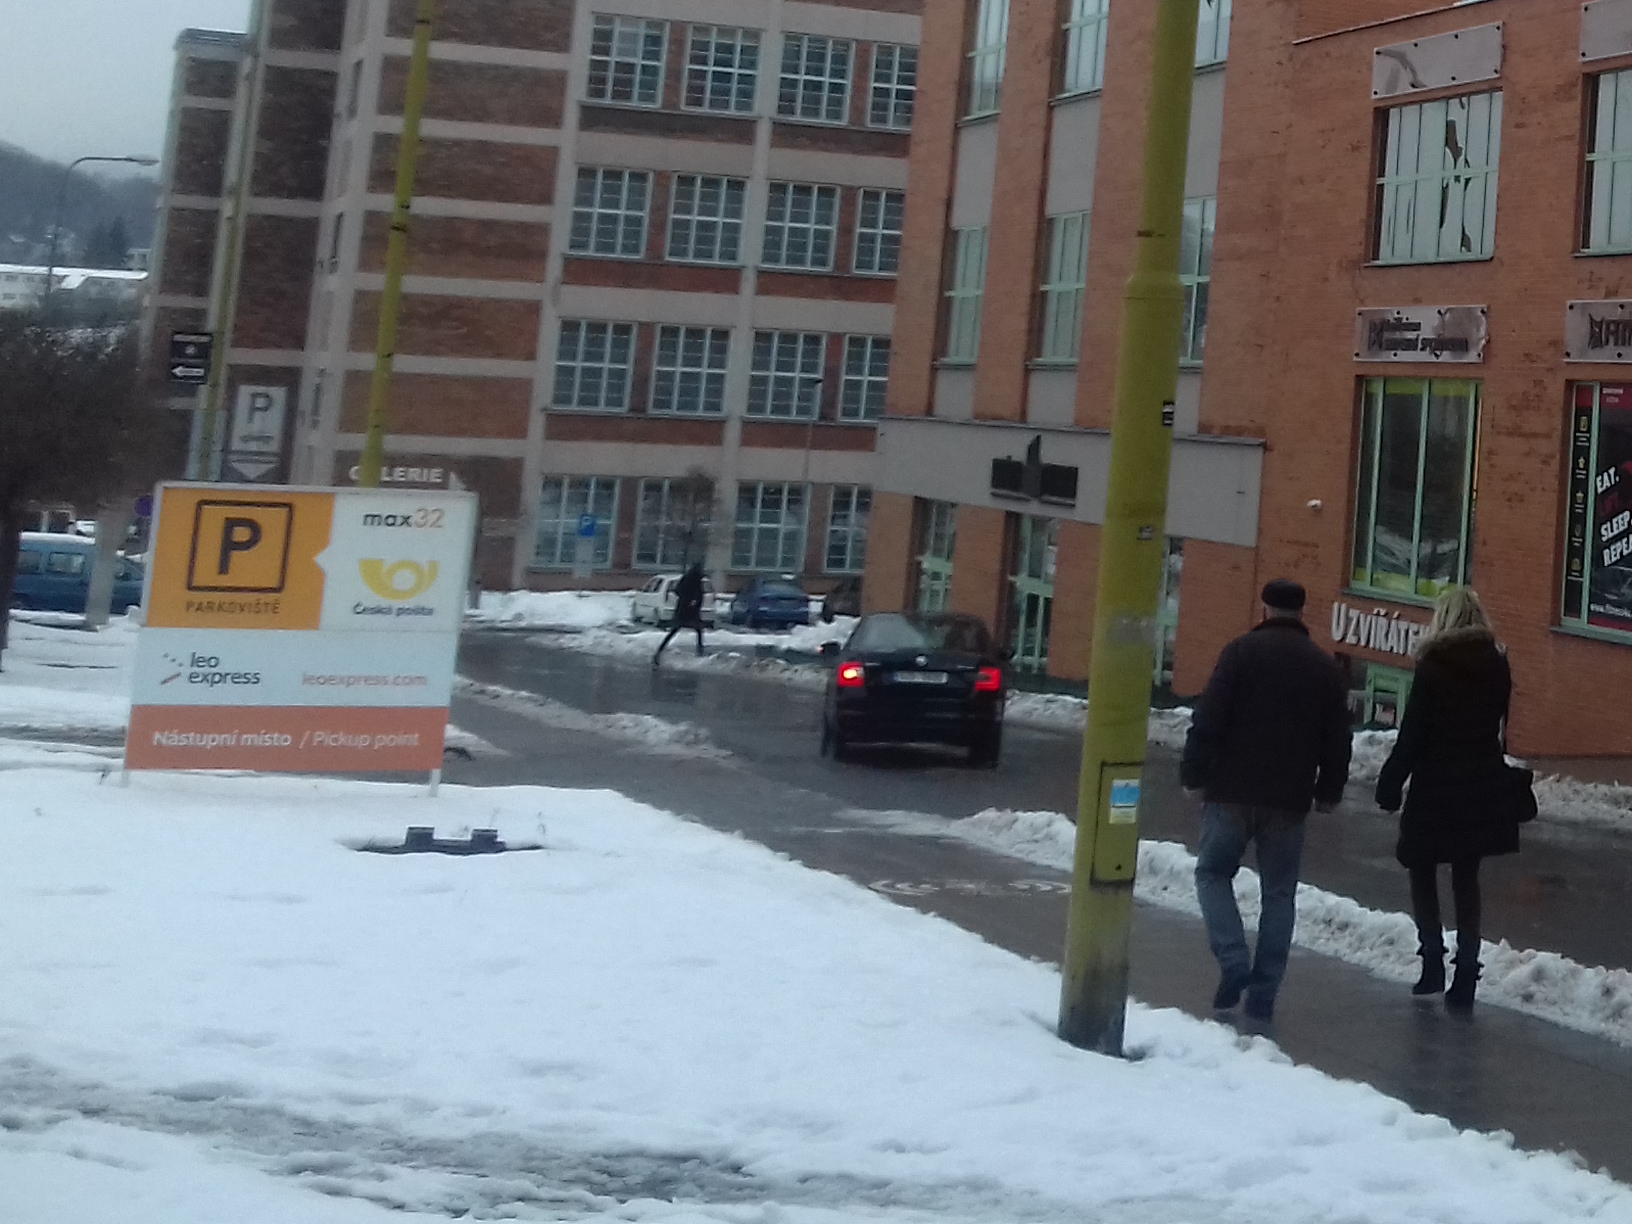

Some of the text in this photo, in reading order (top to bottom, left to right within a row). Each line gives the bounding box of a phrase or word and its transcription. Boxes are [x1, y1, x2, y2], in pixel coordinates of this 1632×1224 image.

[249, 391, 273, 424] P
[1596, 466, 1620, 494] EAT.
[363, 509, 444, 528] max32
[217, 517, 262, 575] P
[190, 652, 219, 669] leo
[188, 671, 261, 687] express
[153, 730, 239, 750] Nástupní
[240, 730, 293, 747] místo
[313, 731, 372, 749] Pickup
[374, 733, 420, 749] point
